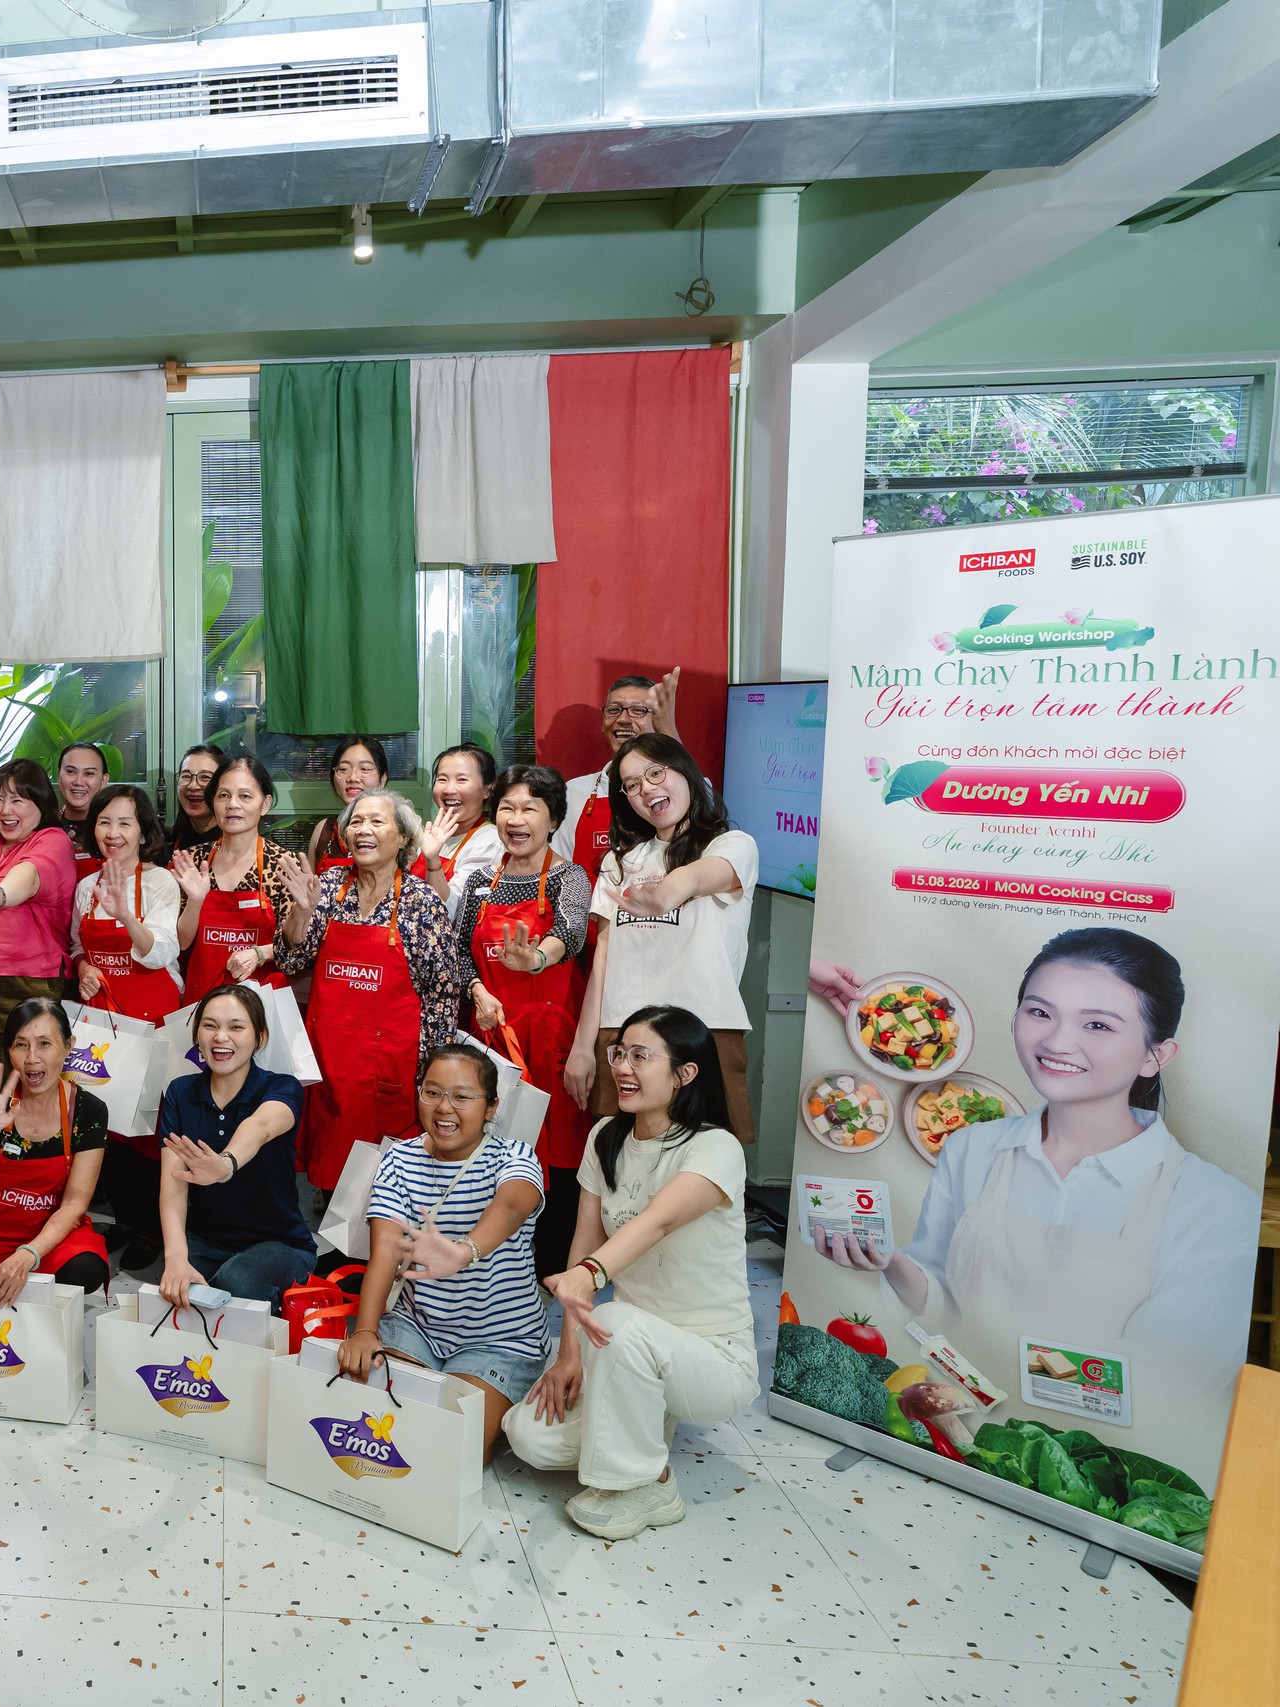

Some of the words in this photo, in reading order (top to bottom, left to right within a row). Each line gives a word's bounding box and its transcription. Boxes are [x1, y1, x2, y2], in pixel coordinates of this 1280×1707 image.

[1072, 538, 1148, 554] SUSTAINABLE
[962, 552, 1032, 570] ICHIBAN
[1094, 554, 1116, 568] U.S.
[1119, 552, 1146, 566] SOY
[998, 568, 1035, 578] FOODS
[972, 632, 1034, 645] Cooking
[1038, 630, 1115, 642] Workshop
[850, 664, 922, 688] Mâm
[934, 658, 1018, 694] Chay
[1030, 653, 1156, 684] Thanh
[1171, 648, 1278, 681] Lành
[864, 684, 937, 728] Gửi
[944, 695, 1024, 722] trọn
[1031, 694, 1108, 716] tâm
[1116, 684, 1246, 716] thành
[800, 712, 825, 722] Cooking
[918, 744, 962, 760] Cùng
[966, 745, 998, 758] đón
[1004, 746, 1059, 758] Khách
[1064, 746, 1098, 759] mời
[1104, 746, 1142, 762] đặc
[1149, 747, 1186, 762] biệt
[942, 781, 1030, 806] Dương
[1039, 780, 1090, 804] Yến
[1097, 784, 1150, 806] Nhi
[980, 822, 1042, 836] Founder
[972, 836, 1028, 864] chay
[1033, 844, 1095, 868] cùng
[1099, 835, 1159, 863] Nhi
[910, 874, 980, 890] 15.08.2026
[994, 880, 1035, 895] MOM
[1038, 884, 1106, 903] Cooking
[1109, 889, 1154, 904] Class
[912, 895, 938, 905] 119/2
[972, 900, 1002, 911] Yersin,
[1046, 907, 1066, 917] Bến
[1070, 909, 1104, 920] Thành,
[1108, 912, 1147, 924] TPHCM
[206, 930, 255, 942] ICHIBAN
[328, 964, 378, 980] ICHIBAN
[350, 981, 378, 992] FOODS
[2, 1190, 53, 1206] ICHIBAN
[153, 1369, 212, 1398] E'mos
[174, 1400, 214, 1410] Premium
[328, 1422, 392, 1462] E'mos
[350, 1460, 394, 1476] Premium
